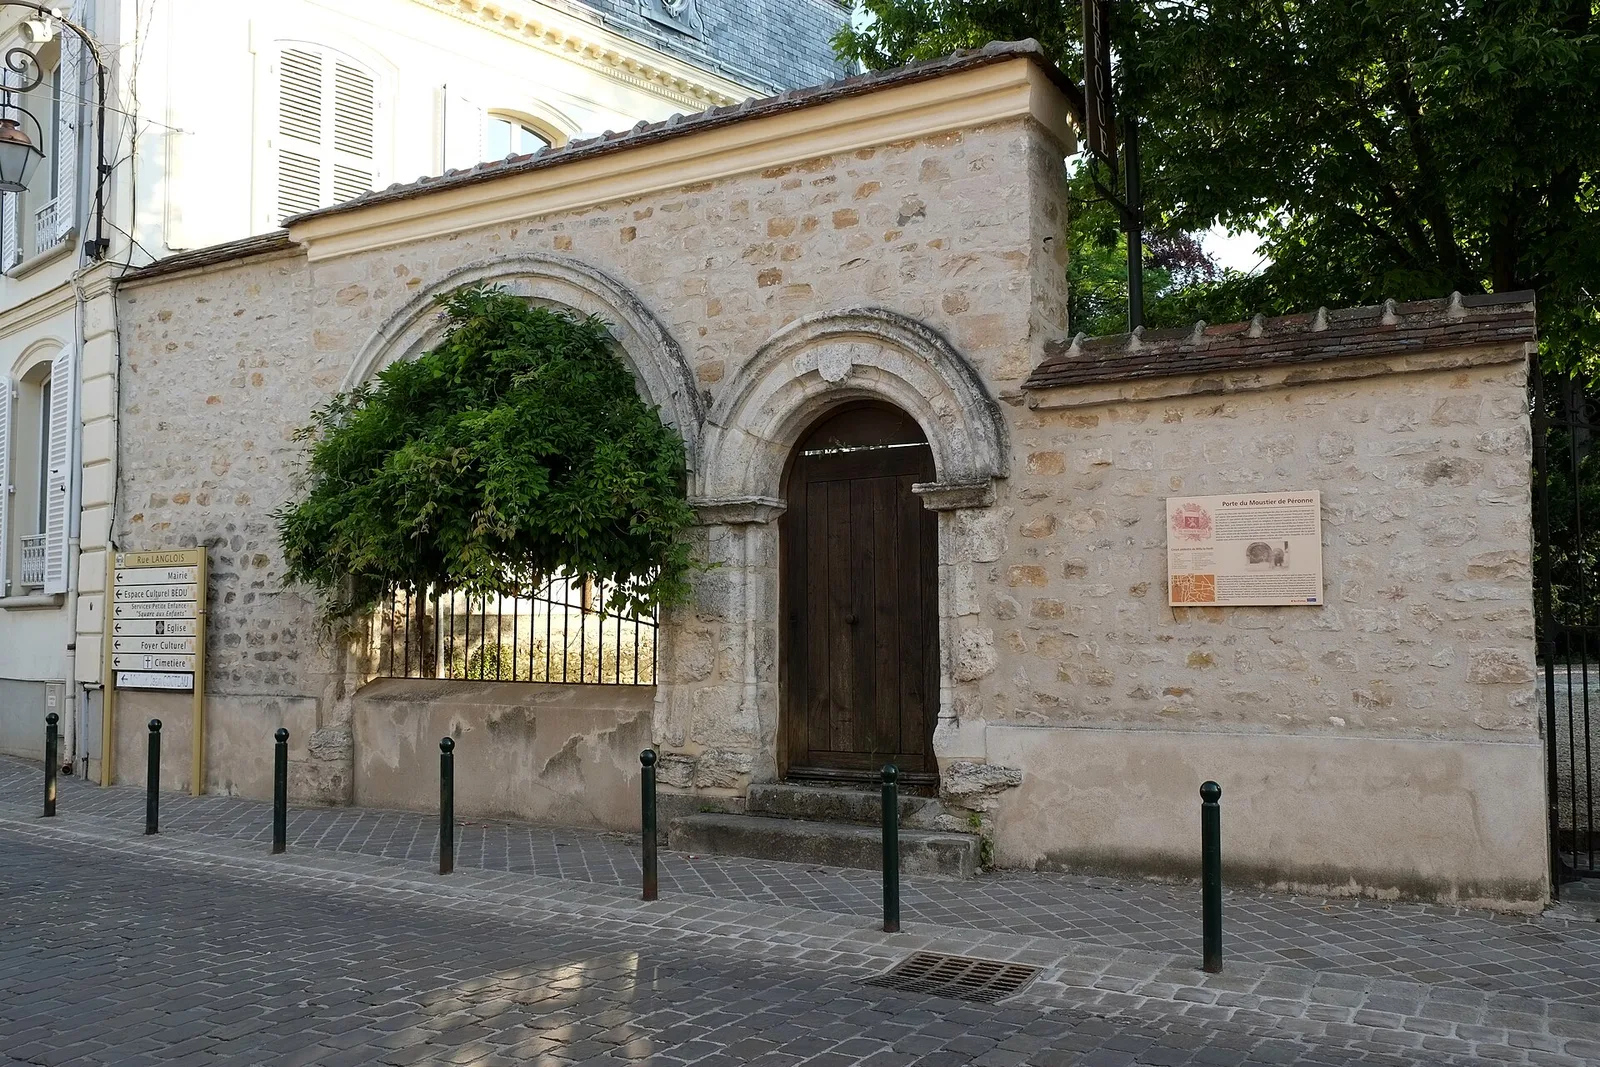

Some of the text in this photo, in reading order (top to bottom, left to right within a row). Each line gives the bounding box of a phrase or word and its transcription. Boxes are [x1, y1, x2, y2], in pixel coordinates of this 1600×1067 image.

[137, 553, 185, 564] Rue LANGLOIS
[167, 572, 188, 580] Mairie
[124, 590, 144, 599] Espace
[145, 589, 170, 598] Culturel
[141, 641, 187, 651] Foyer Culturel
[154, 658, 186, 667] Cimetière
